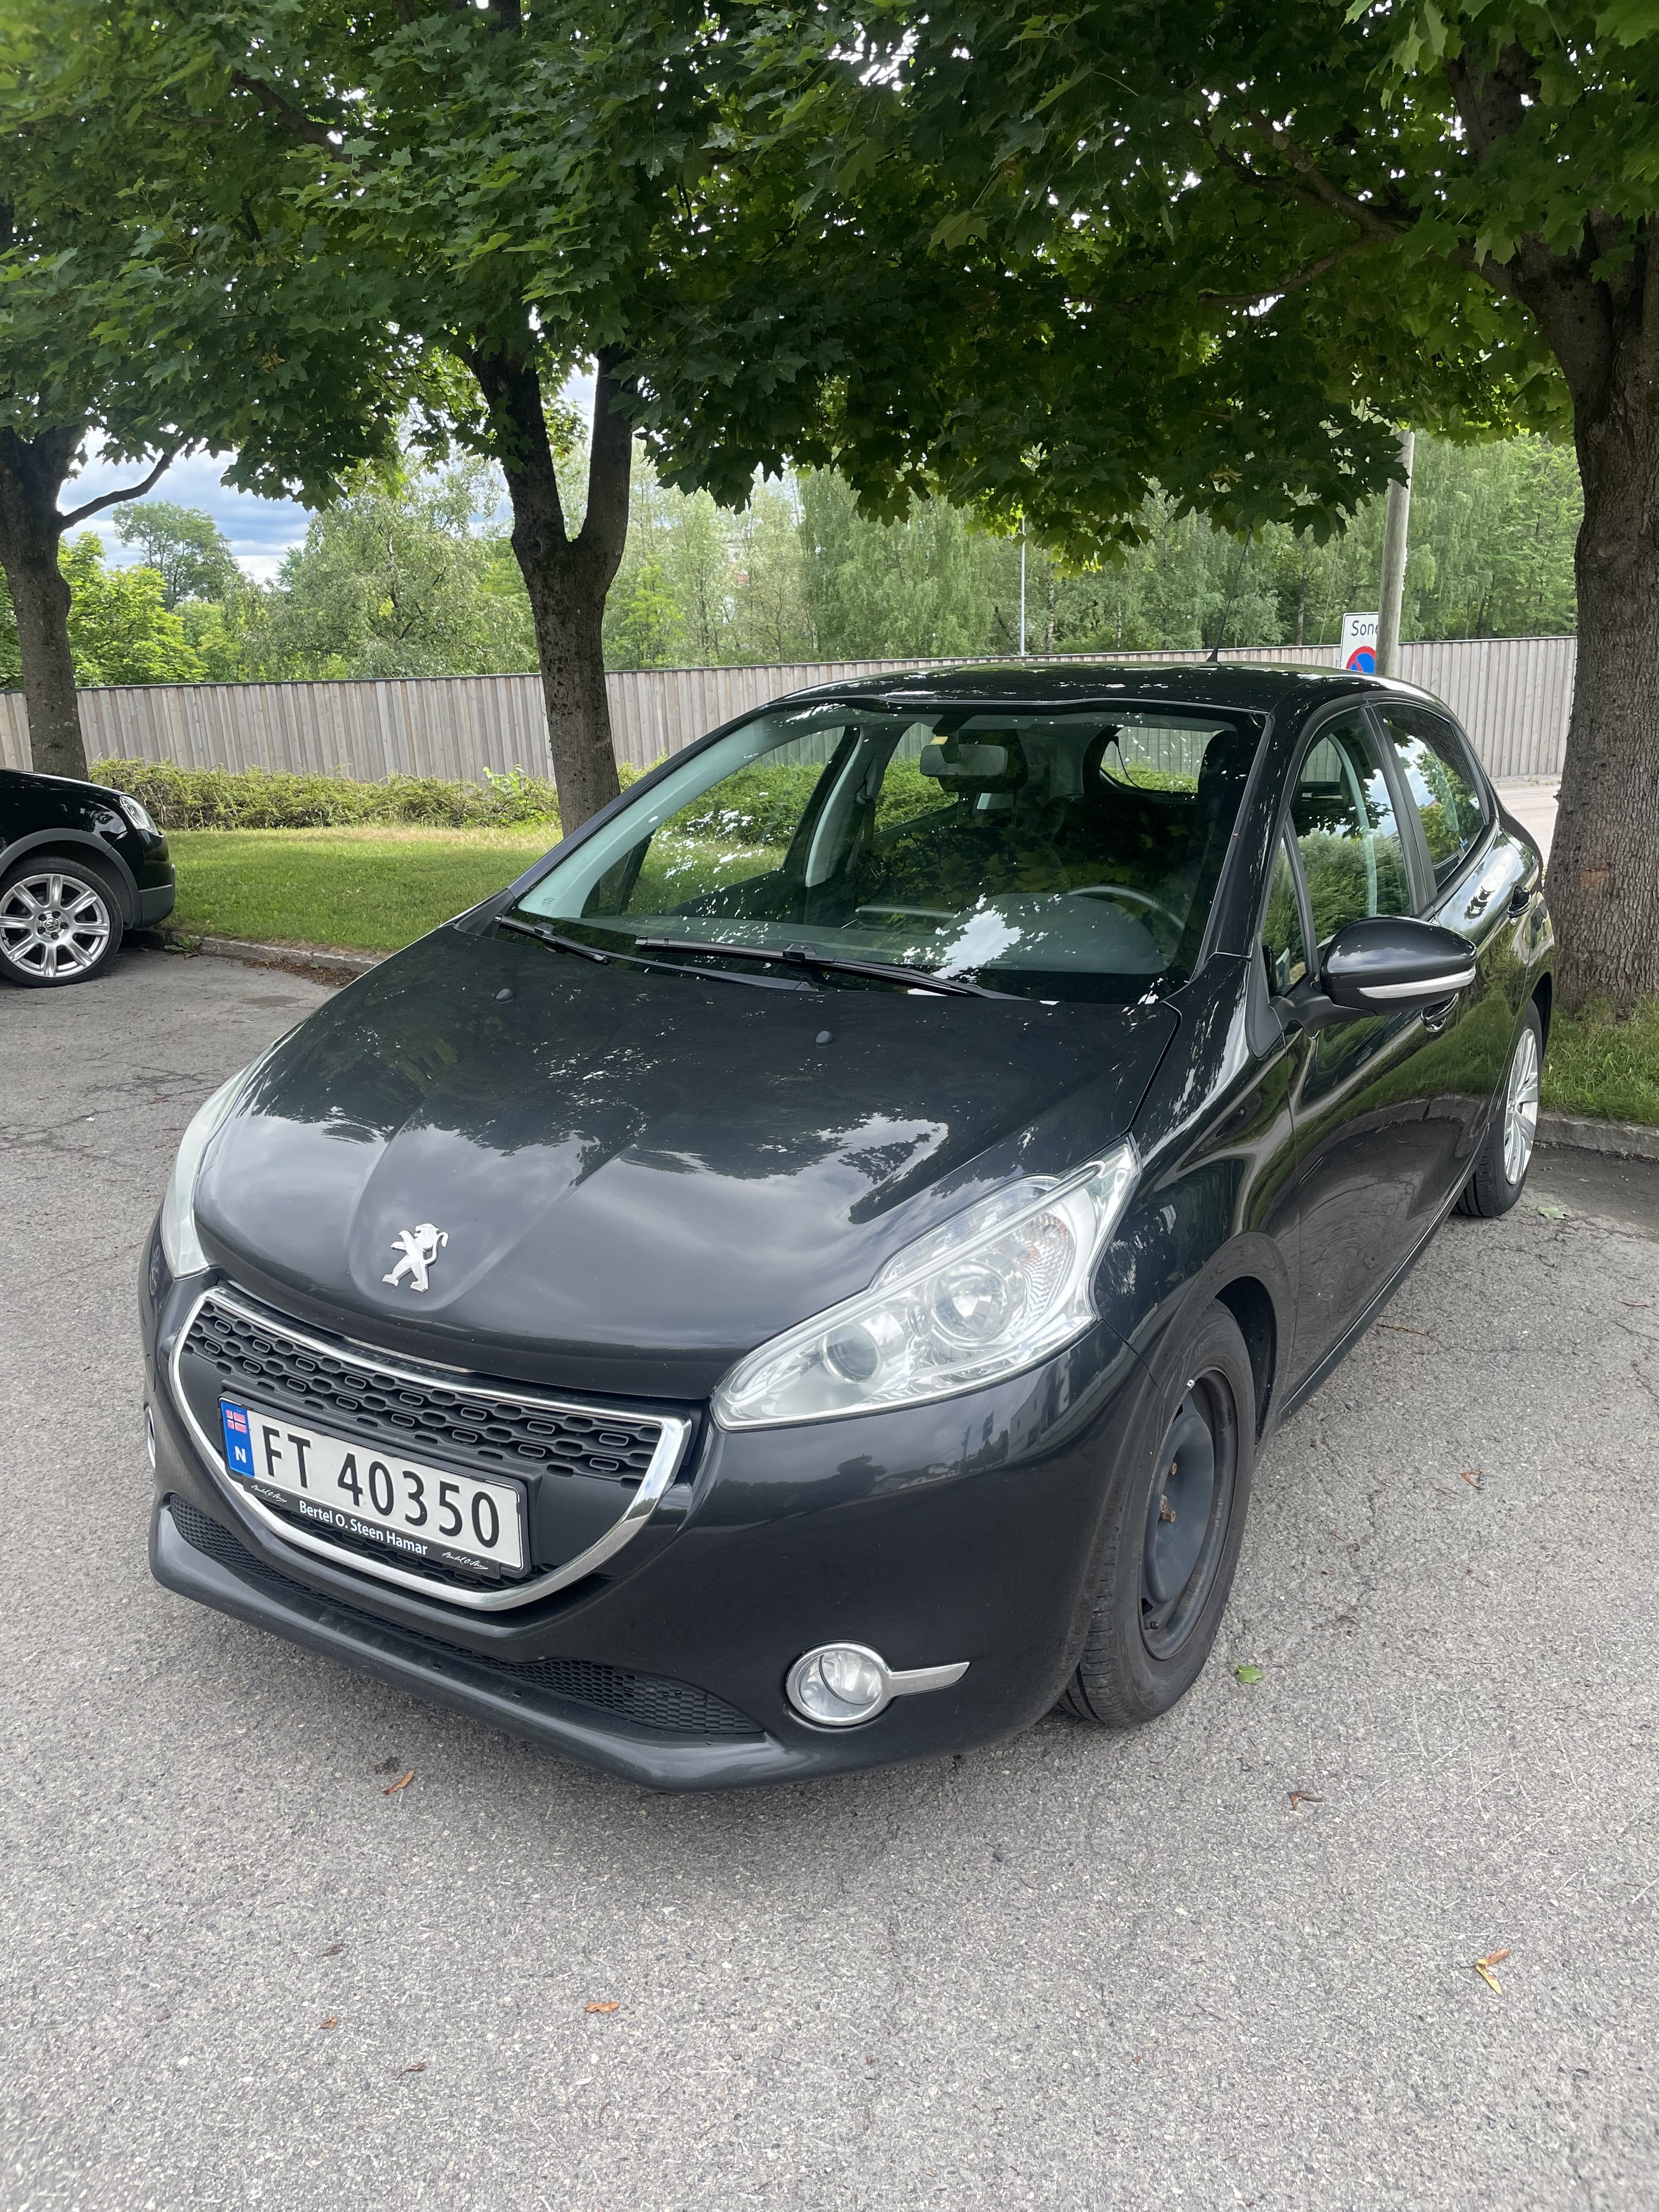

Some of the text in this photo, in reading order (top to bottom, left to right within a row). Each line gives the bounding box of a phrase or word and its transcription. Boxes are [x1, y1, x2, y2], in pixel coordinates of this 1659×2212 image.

[1351, 620, 1378, 636] Son
[234, 1445, 247, 1464] N
[262, 1424, 500, 1548] FT 40350
[299, 1500, 428, 1555] Bertel O. Steen Hamar
